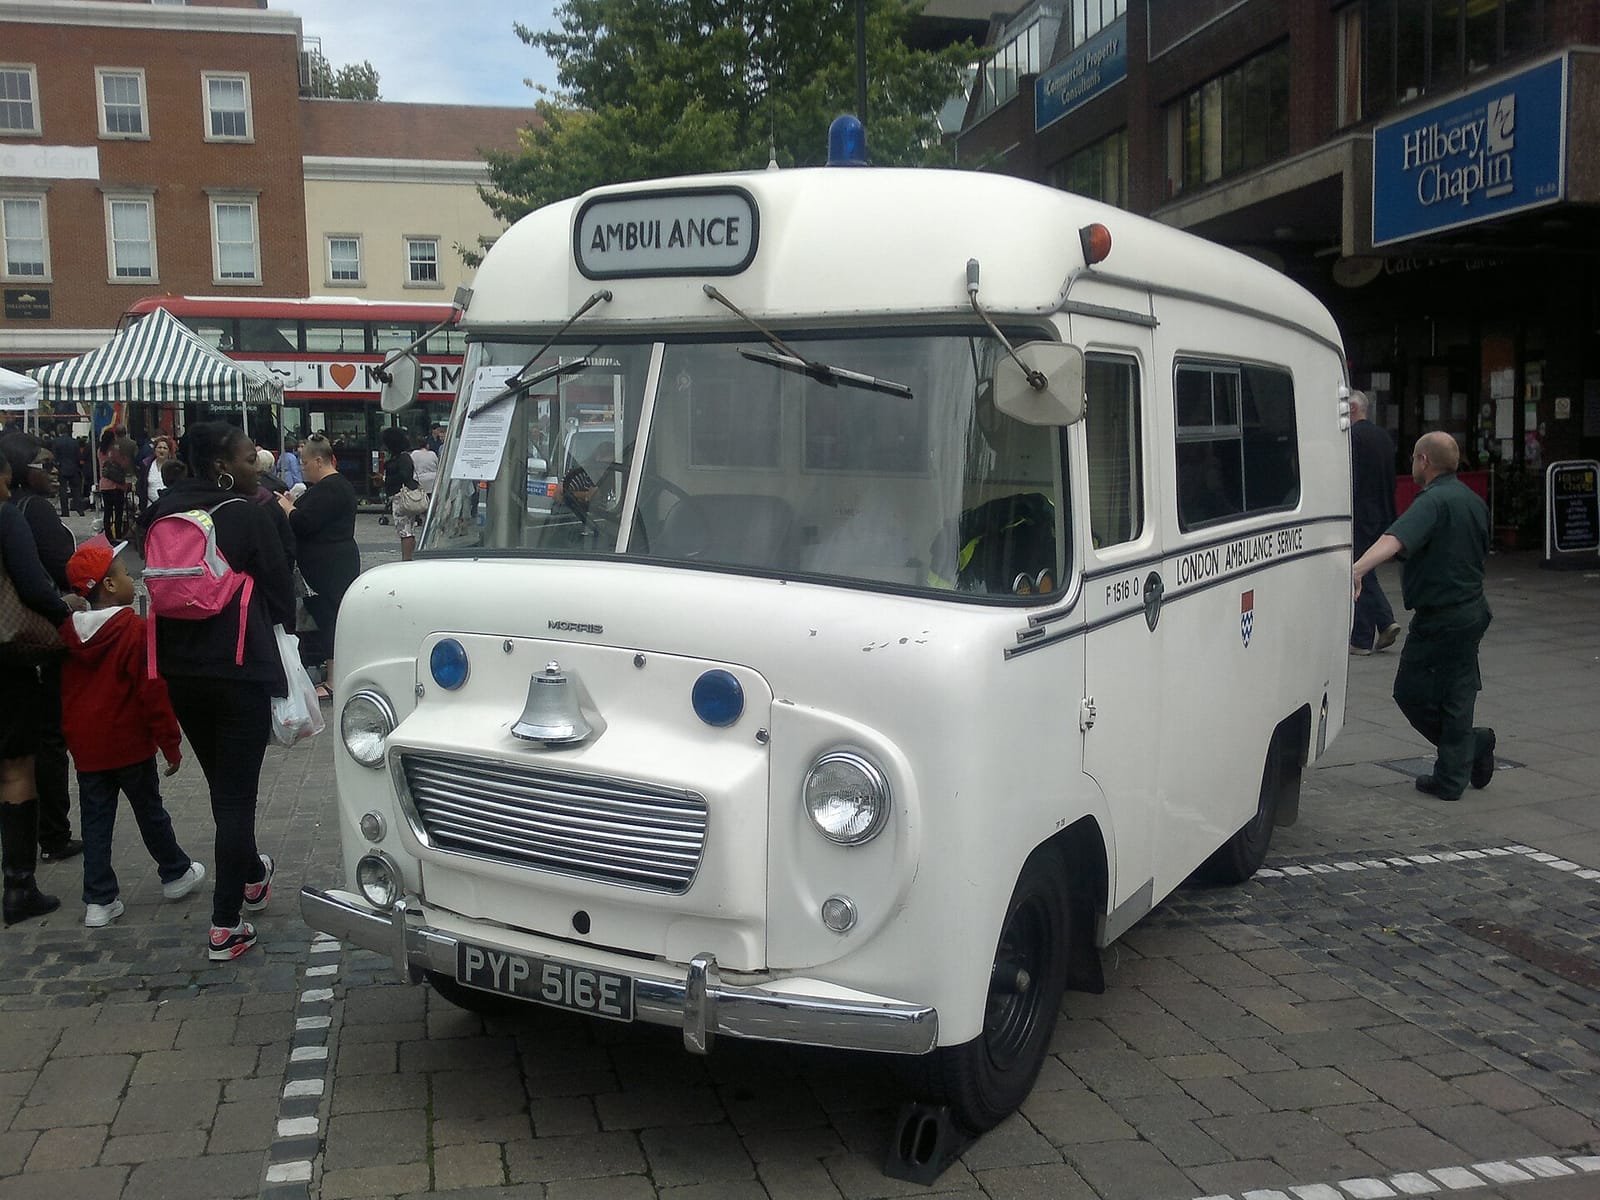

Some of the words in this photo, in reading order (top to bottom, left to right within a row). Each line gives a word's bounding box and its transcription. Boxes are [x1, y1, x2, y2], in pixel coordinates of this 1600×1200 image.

[1046, 56, 1085, 97] Commercial
[1086, 39, 1120, 70] Property
[1061, 70, 1102, 105] Consultants
[1402, 118, 1488, 170] Hilbery
[1417, 149, 1513, 206] Chaplin
[210, 403, 233, 412] Special
[1176, 550, 1219, 586] LONDON
[1225, 535, 1273, 571] AMBULANCE
[1277, 528, 1303, 554] SERVICE
[547, 620, 604, 634] MORRIS
[465, 946, 530, 993] PYP
[541, 964, 622, 1016] 516E
